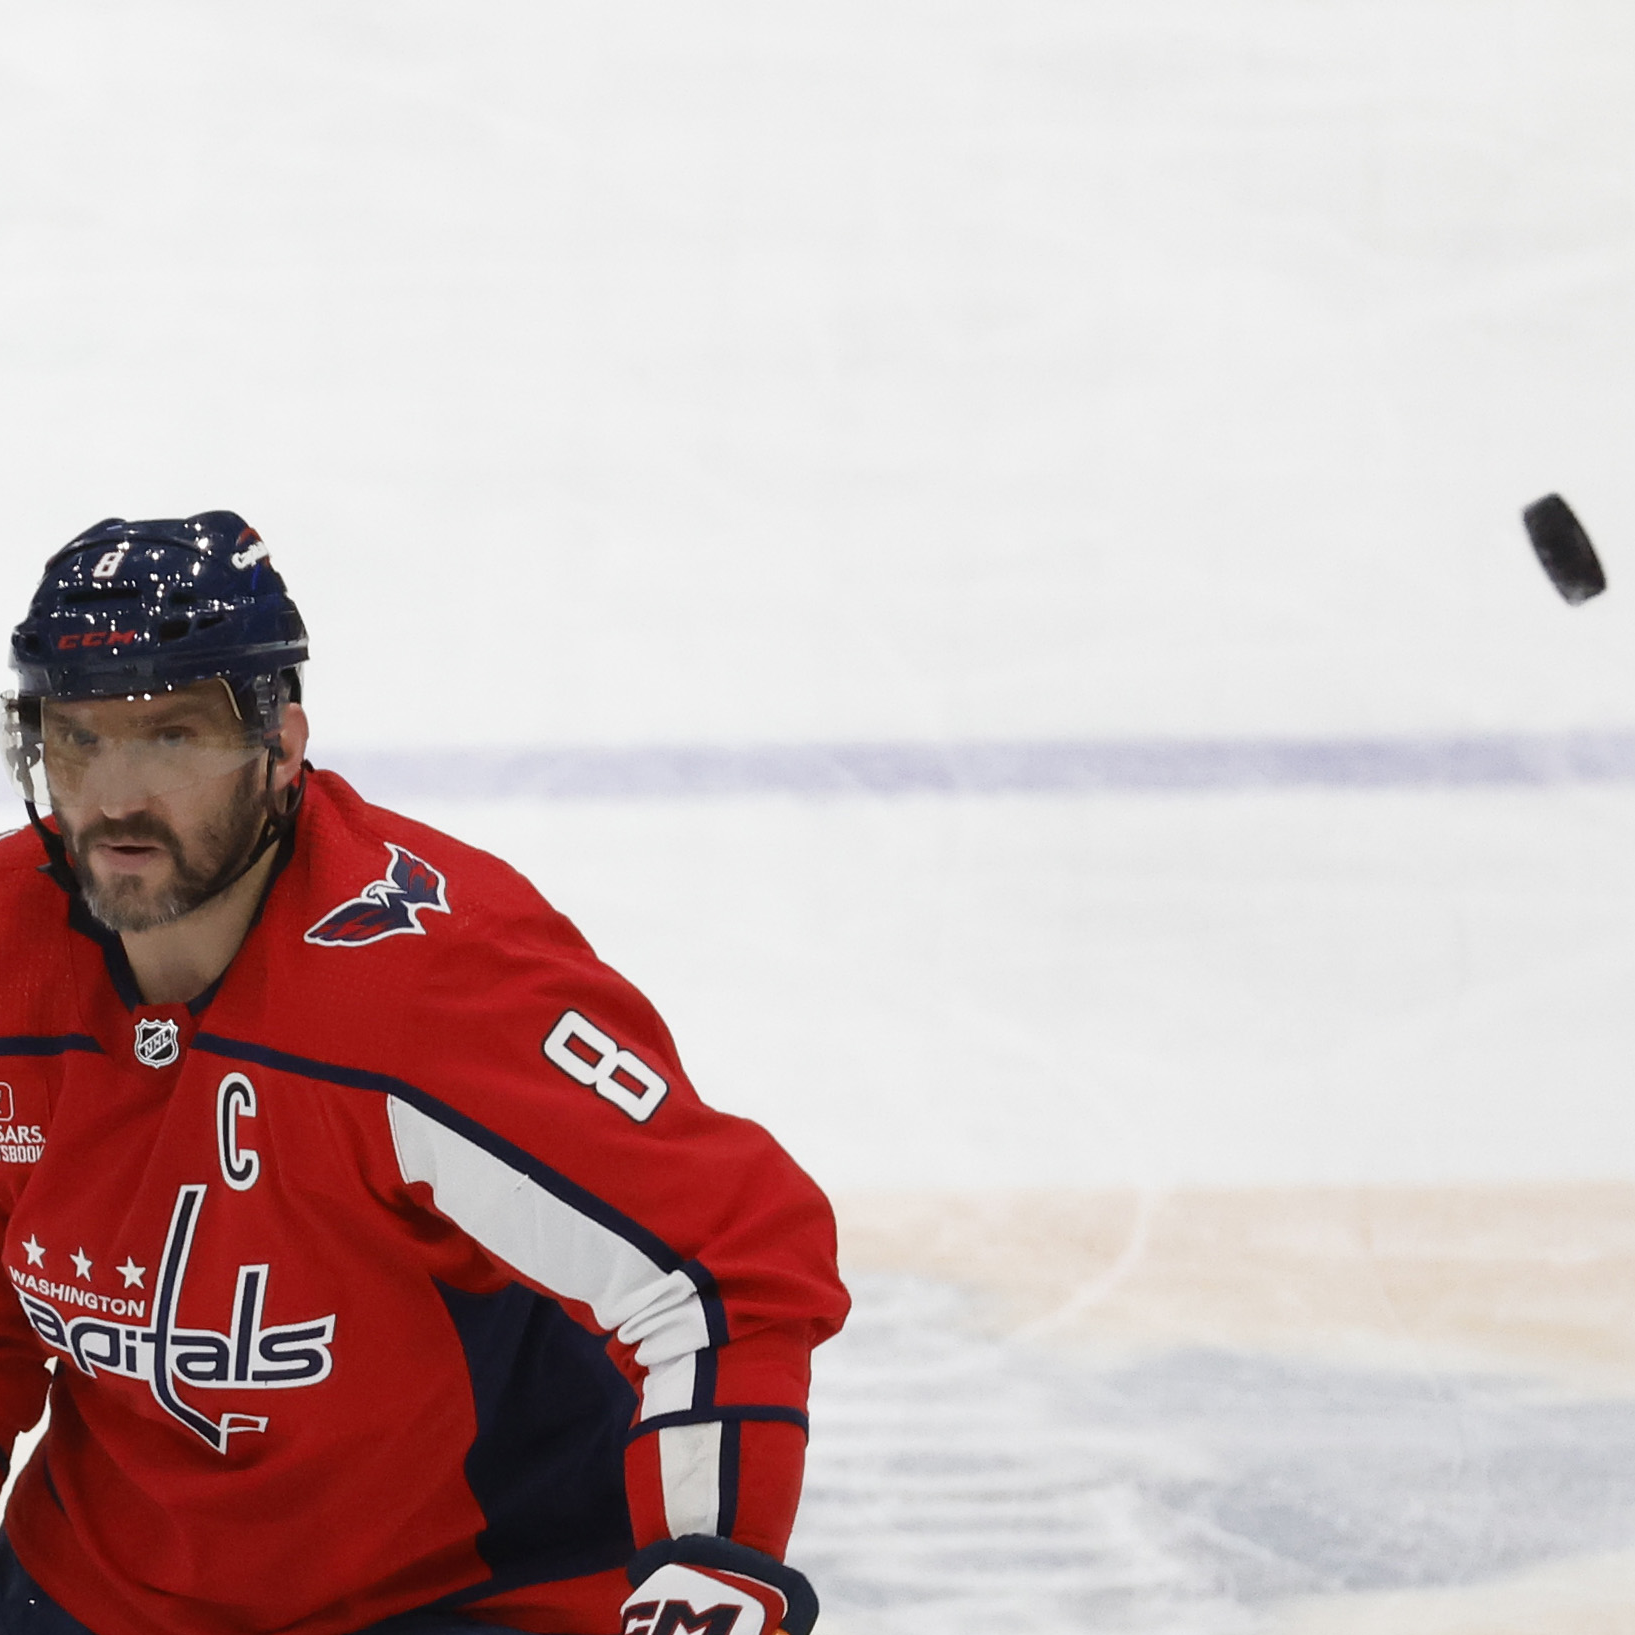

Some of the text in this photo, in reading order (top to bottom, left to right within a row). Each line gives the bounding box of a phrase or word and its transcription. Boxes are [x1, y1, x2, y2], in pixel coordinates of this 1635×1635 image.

[92, 551, 124, 579] 8
[58, 629, 137, 650] CCM
[542, 1008, 670, 1124] 8
[216, 1072, 260, 1191] C
[9, 1266, 146, 1318] WASHINGTON
